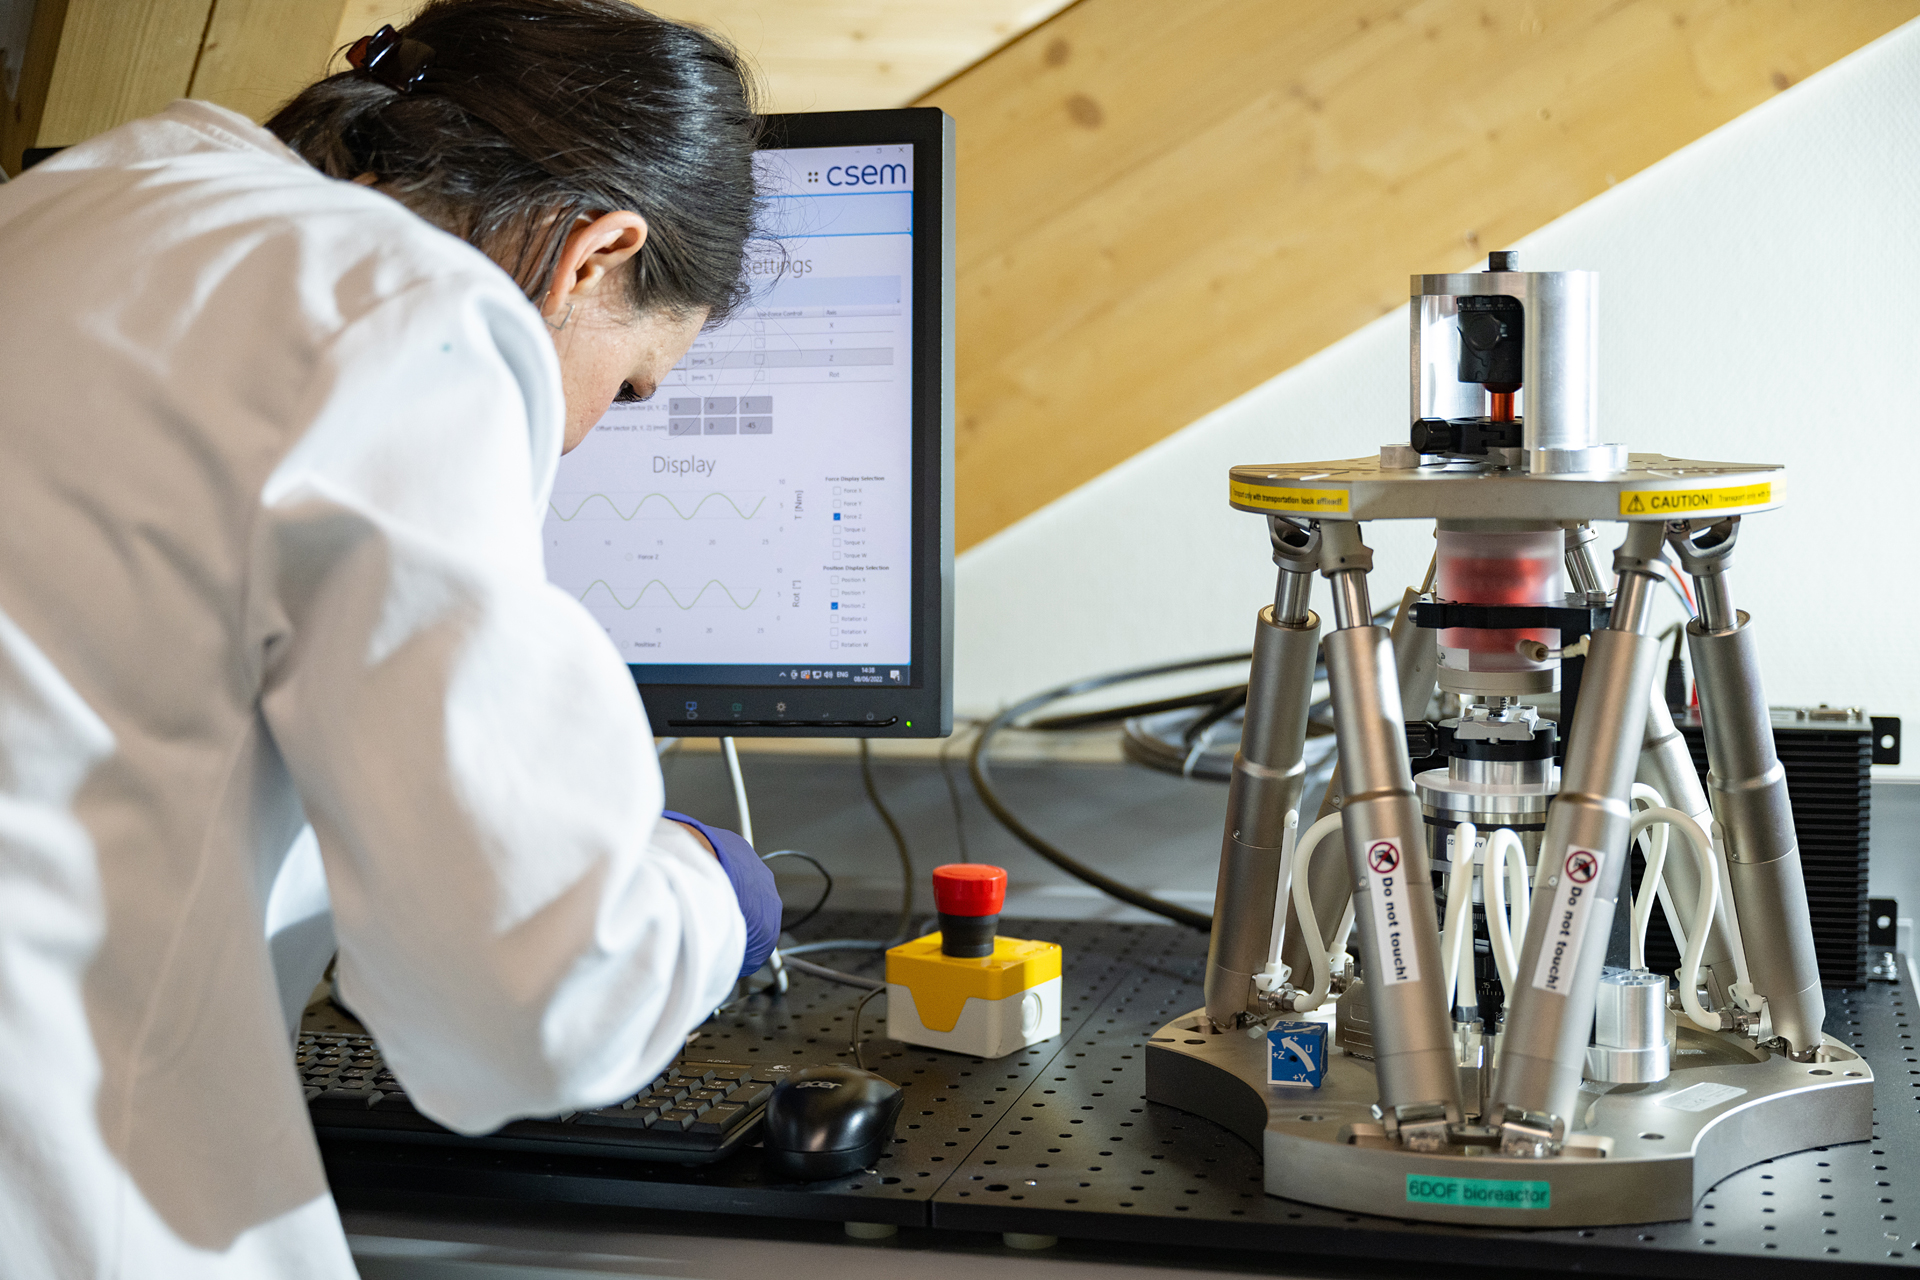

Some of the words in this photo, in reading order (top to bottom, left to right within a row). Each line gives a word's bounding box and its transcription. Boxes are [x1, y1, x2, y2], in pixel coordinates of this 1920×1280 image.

[826, 164, 906, 186] csem
[652, 455, 716, 477] Display
[1262, 494, 1300, 504] transportation
[1301, 496, 1314, 505] lock
[1651, 493, 1713, 509] CAUTION!
[1382, 877, 1394, 896] Do
[1568, 886, 1582, 906] Do
[1386, 902, 1398, 927] not
[1560, 910, 1573, 936] not
[1390, 932, 1408, 980] touch!
[1546, 941, 1567, 990] touch!
[1272, 1050, 1285, 1060] +Z
[1305, 1044, 1313, 1053] U
[796, 1081, 842, 1090] acer
[1292, 1073, 1306, 1082] +Y
[1408, 1180, 1458, 1198] 6DOF
[1463, 1184, 1547, 1203] bioreactor
